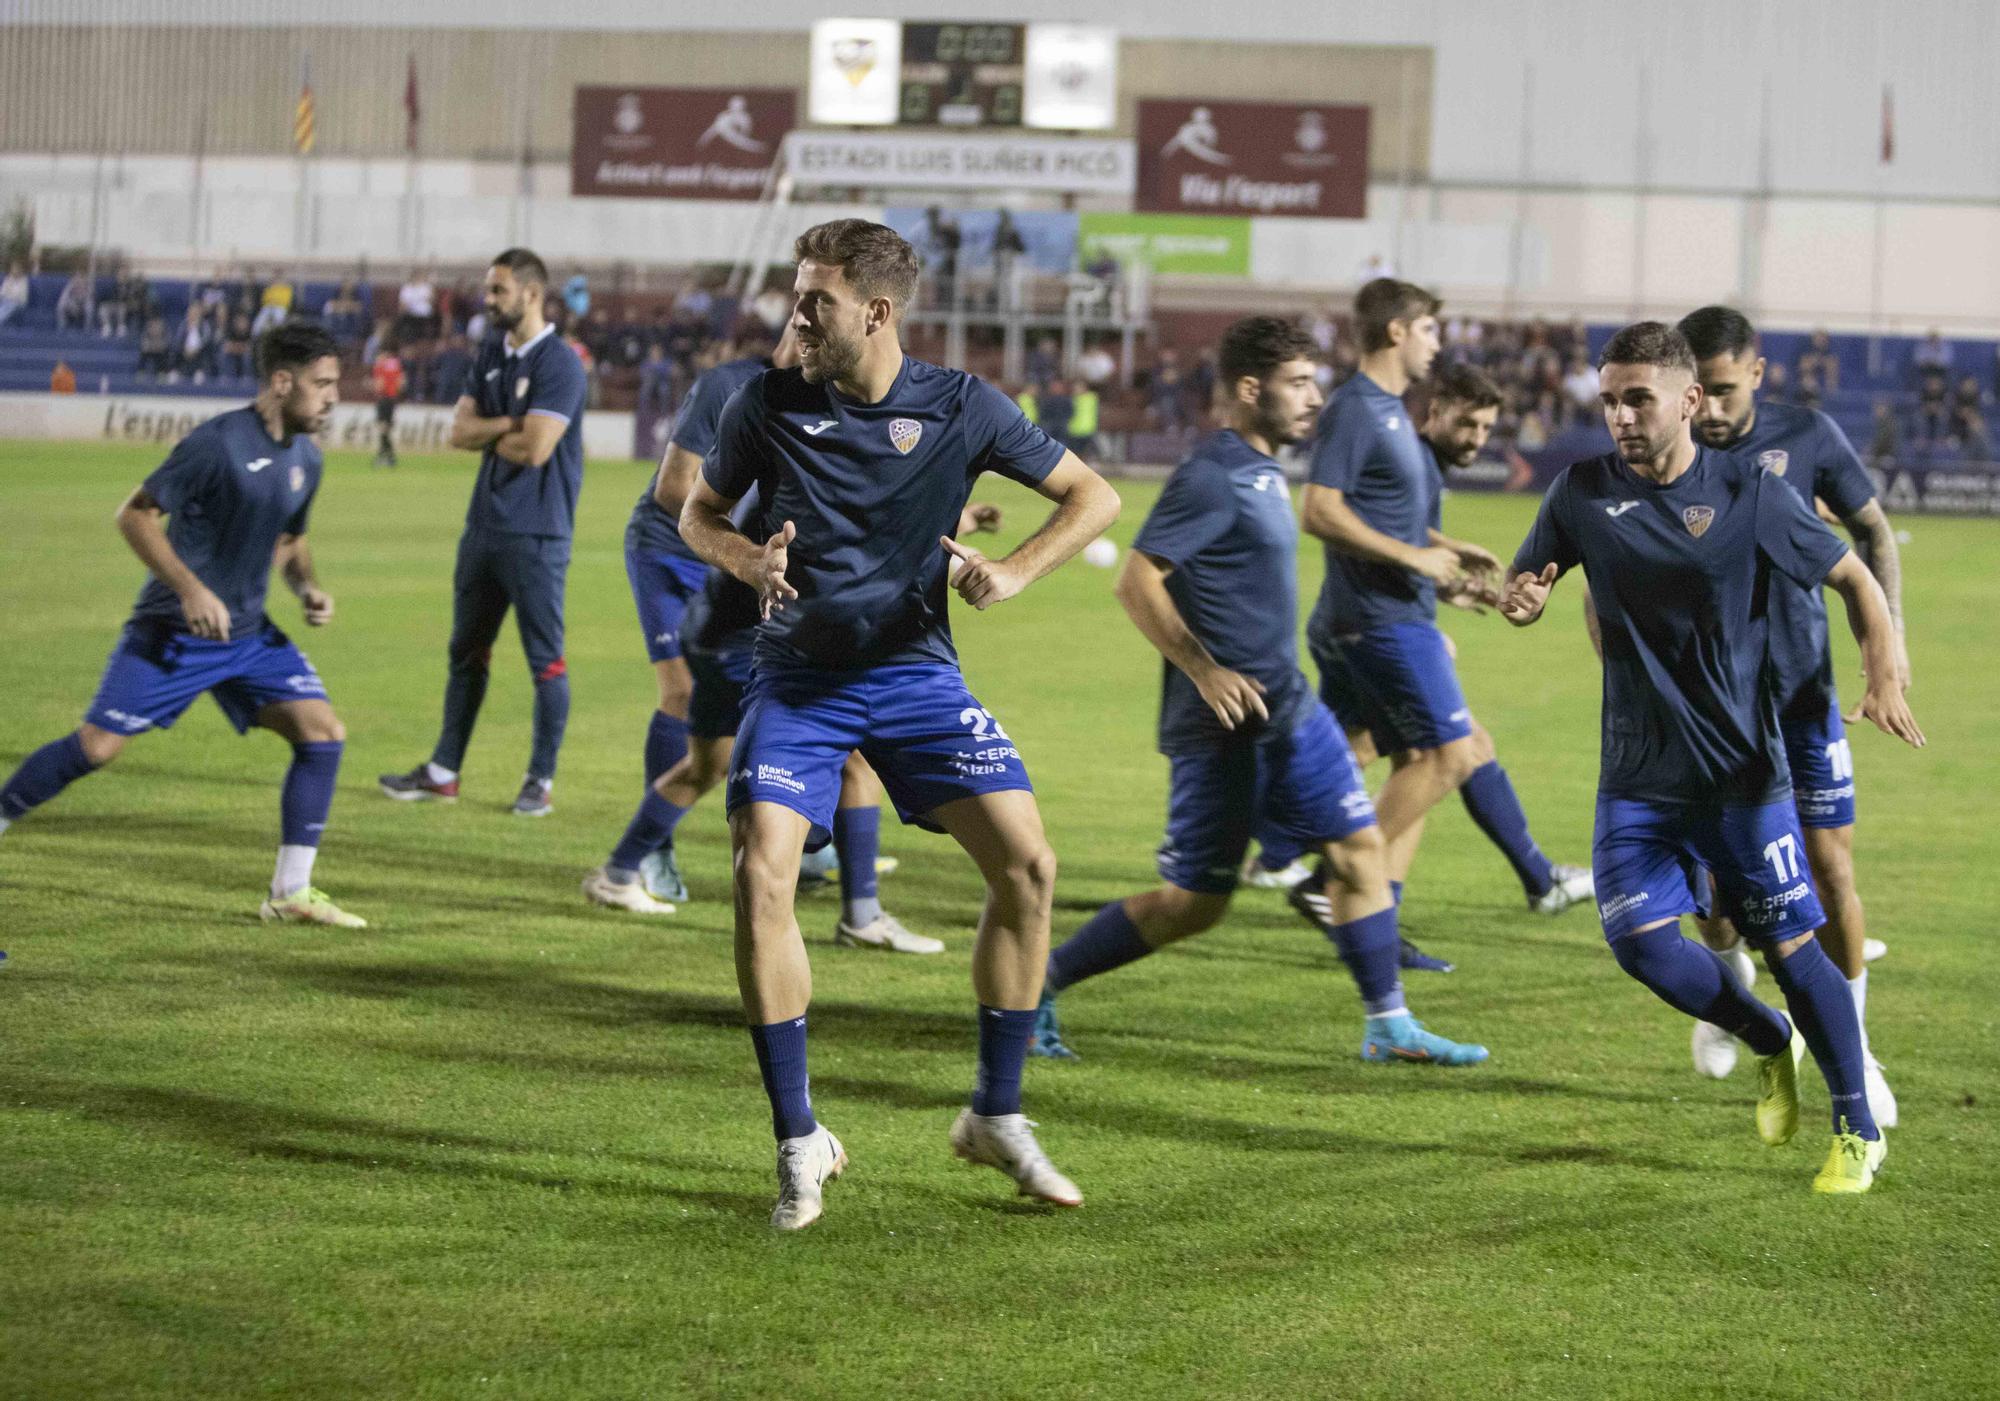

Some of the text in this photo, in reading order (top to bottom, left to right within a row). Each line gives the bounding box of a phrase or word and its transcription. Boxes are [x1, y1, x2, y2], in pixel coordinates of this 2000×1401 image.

[800, 143, 1121, 178] ESTADI LUIS SUÑER PICÓ
[103, 399, 206, 444] L'espo
[975, 747, 1021, 760] CEPS
[1763, 832, 1799, 884] 17
